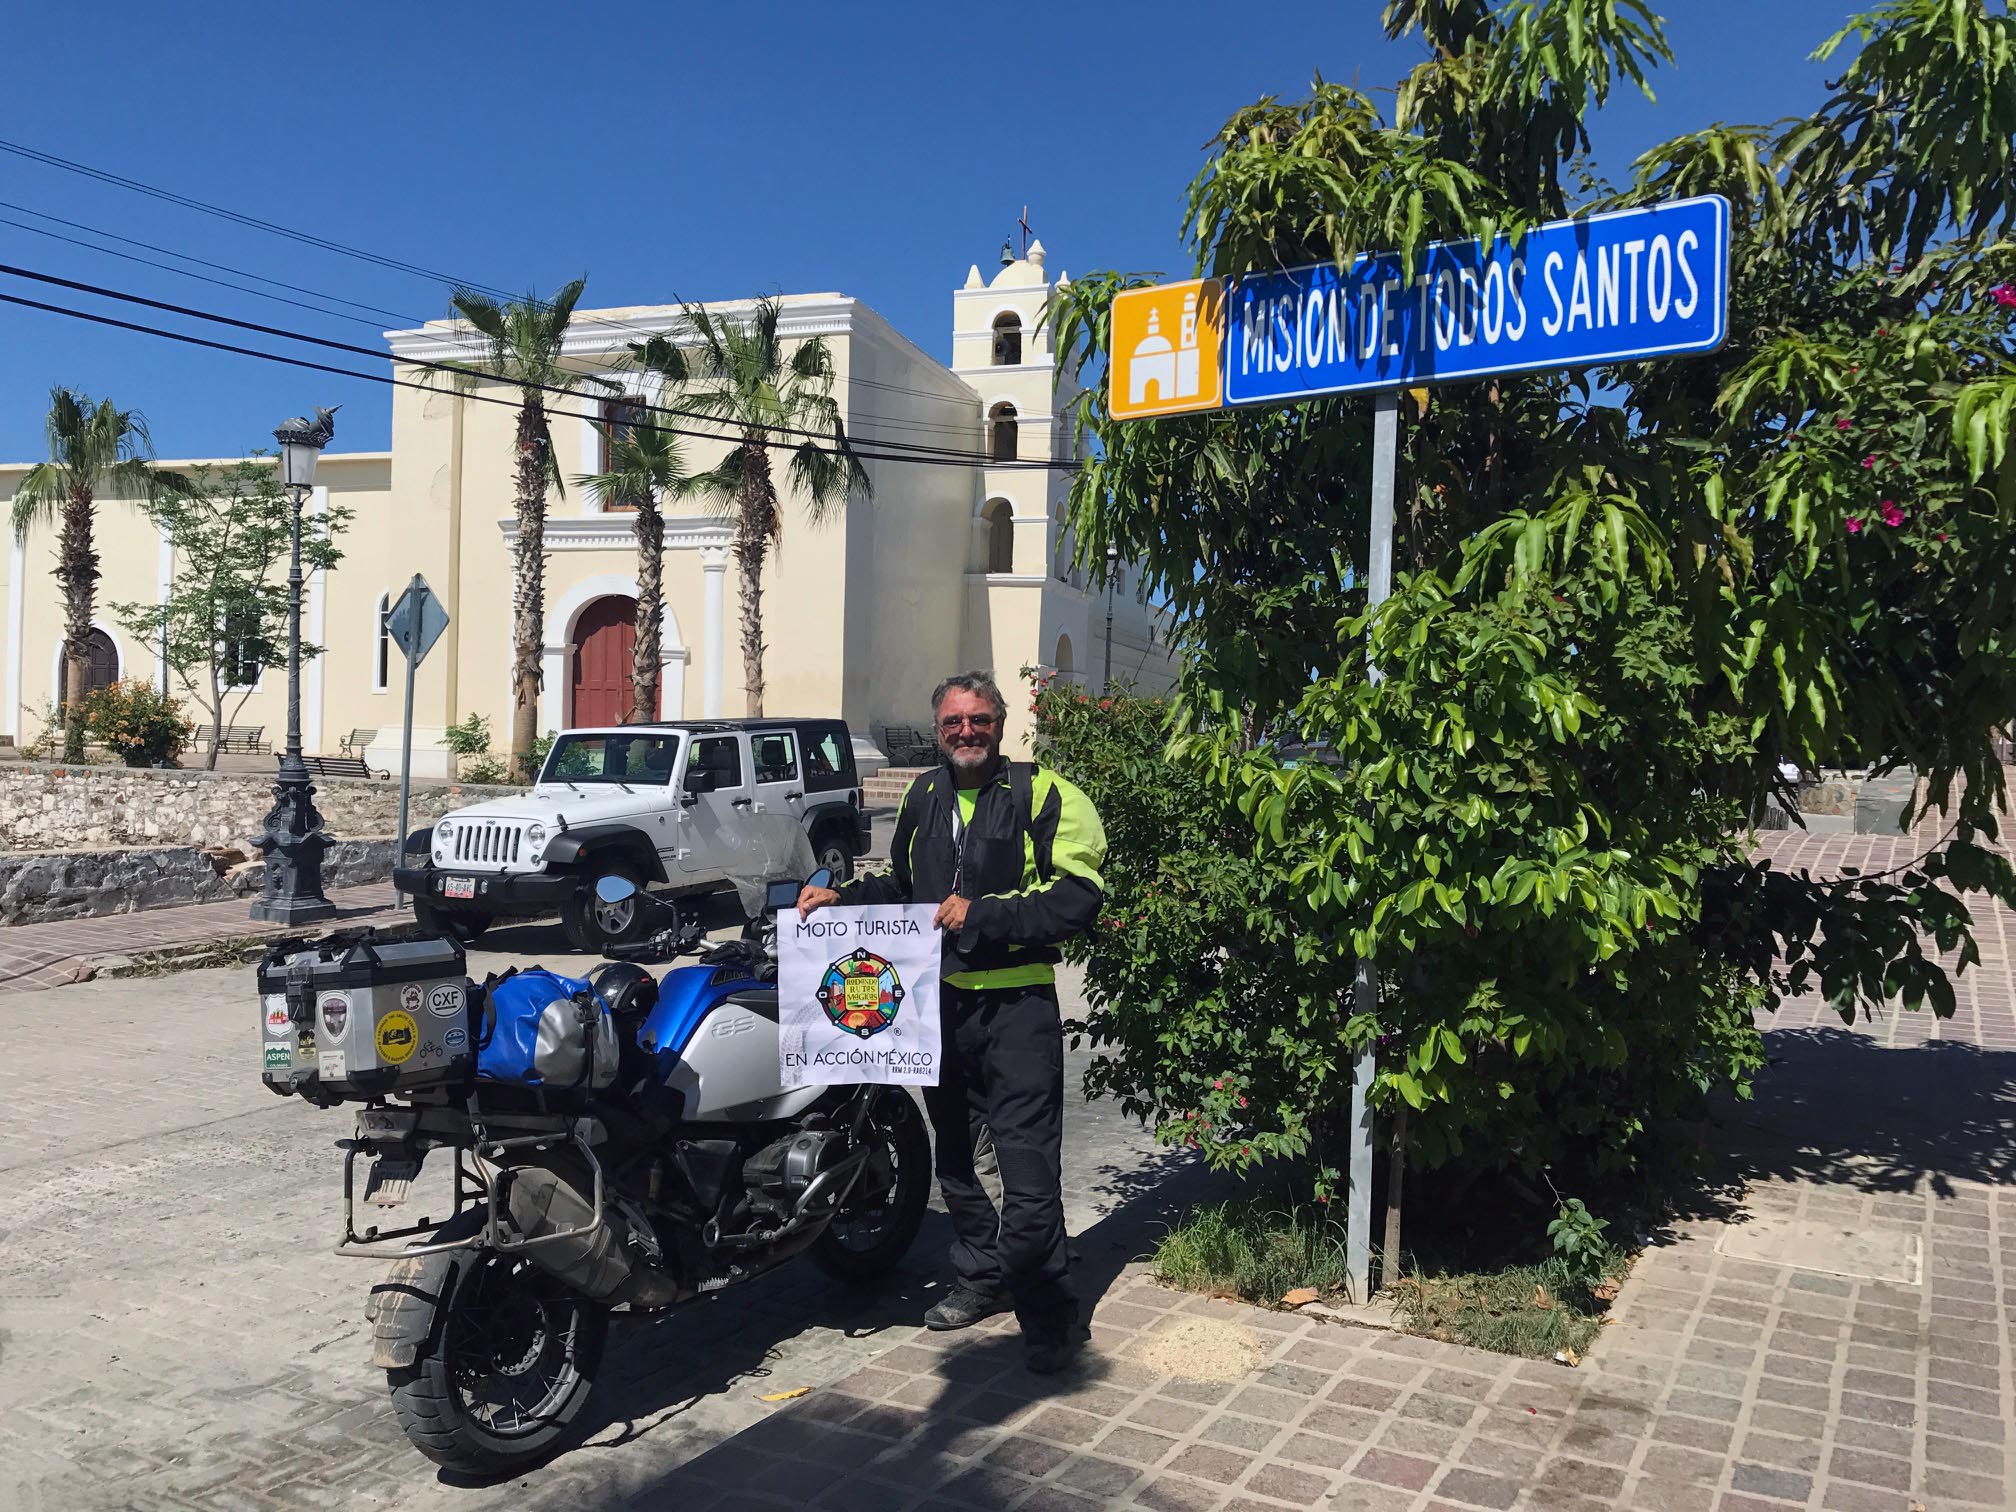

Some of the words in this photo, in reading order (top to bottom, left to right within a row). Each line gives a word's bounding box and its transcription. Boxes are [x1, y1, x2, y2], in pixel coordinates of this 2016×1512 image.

[1359, 278, 1401, 360] DE
[1416, 256, 1528, 354] TODOS
[1543, 229, 1699, 337] SANTOS
[796, 922, 848, 938] MOTO
[855, 919, 921, 936] TURISTA
[857, 951, 866, 959] N
[432, 991, 459, 1007] CXF
[861, 1028, 869, 1036] S
[266, 1052, 290, 1061] ASPEN
[785, 1053, 807, 1067] EN
[813, 1047, 874, 1066] ACCIÓN
[877, 1048, 933, 1067] MÉXICO
